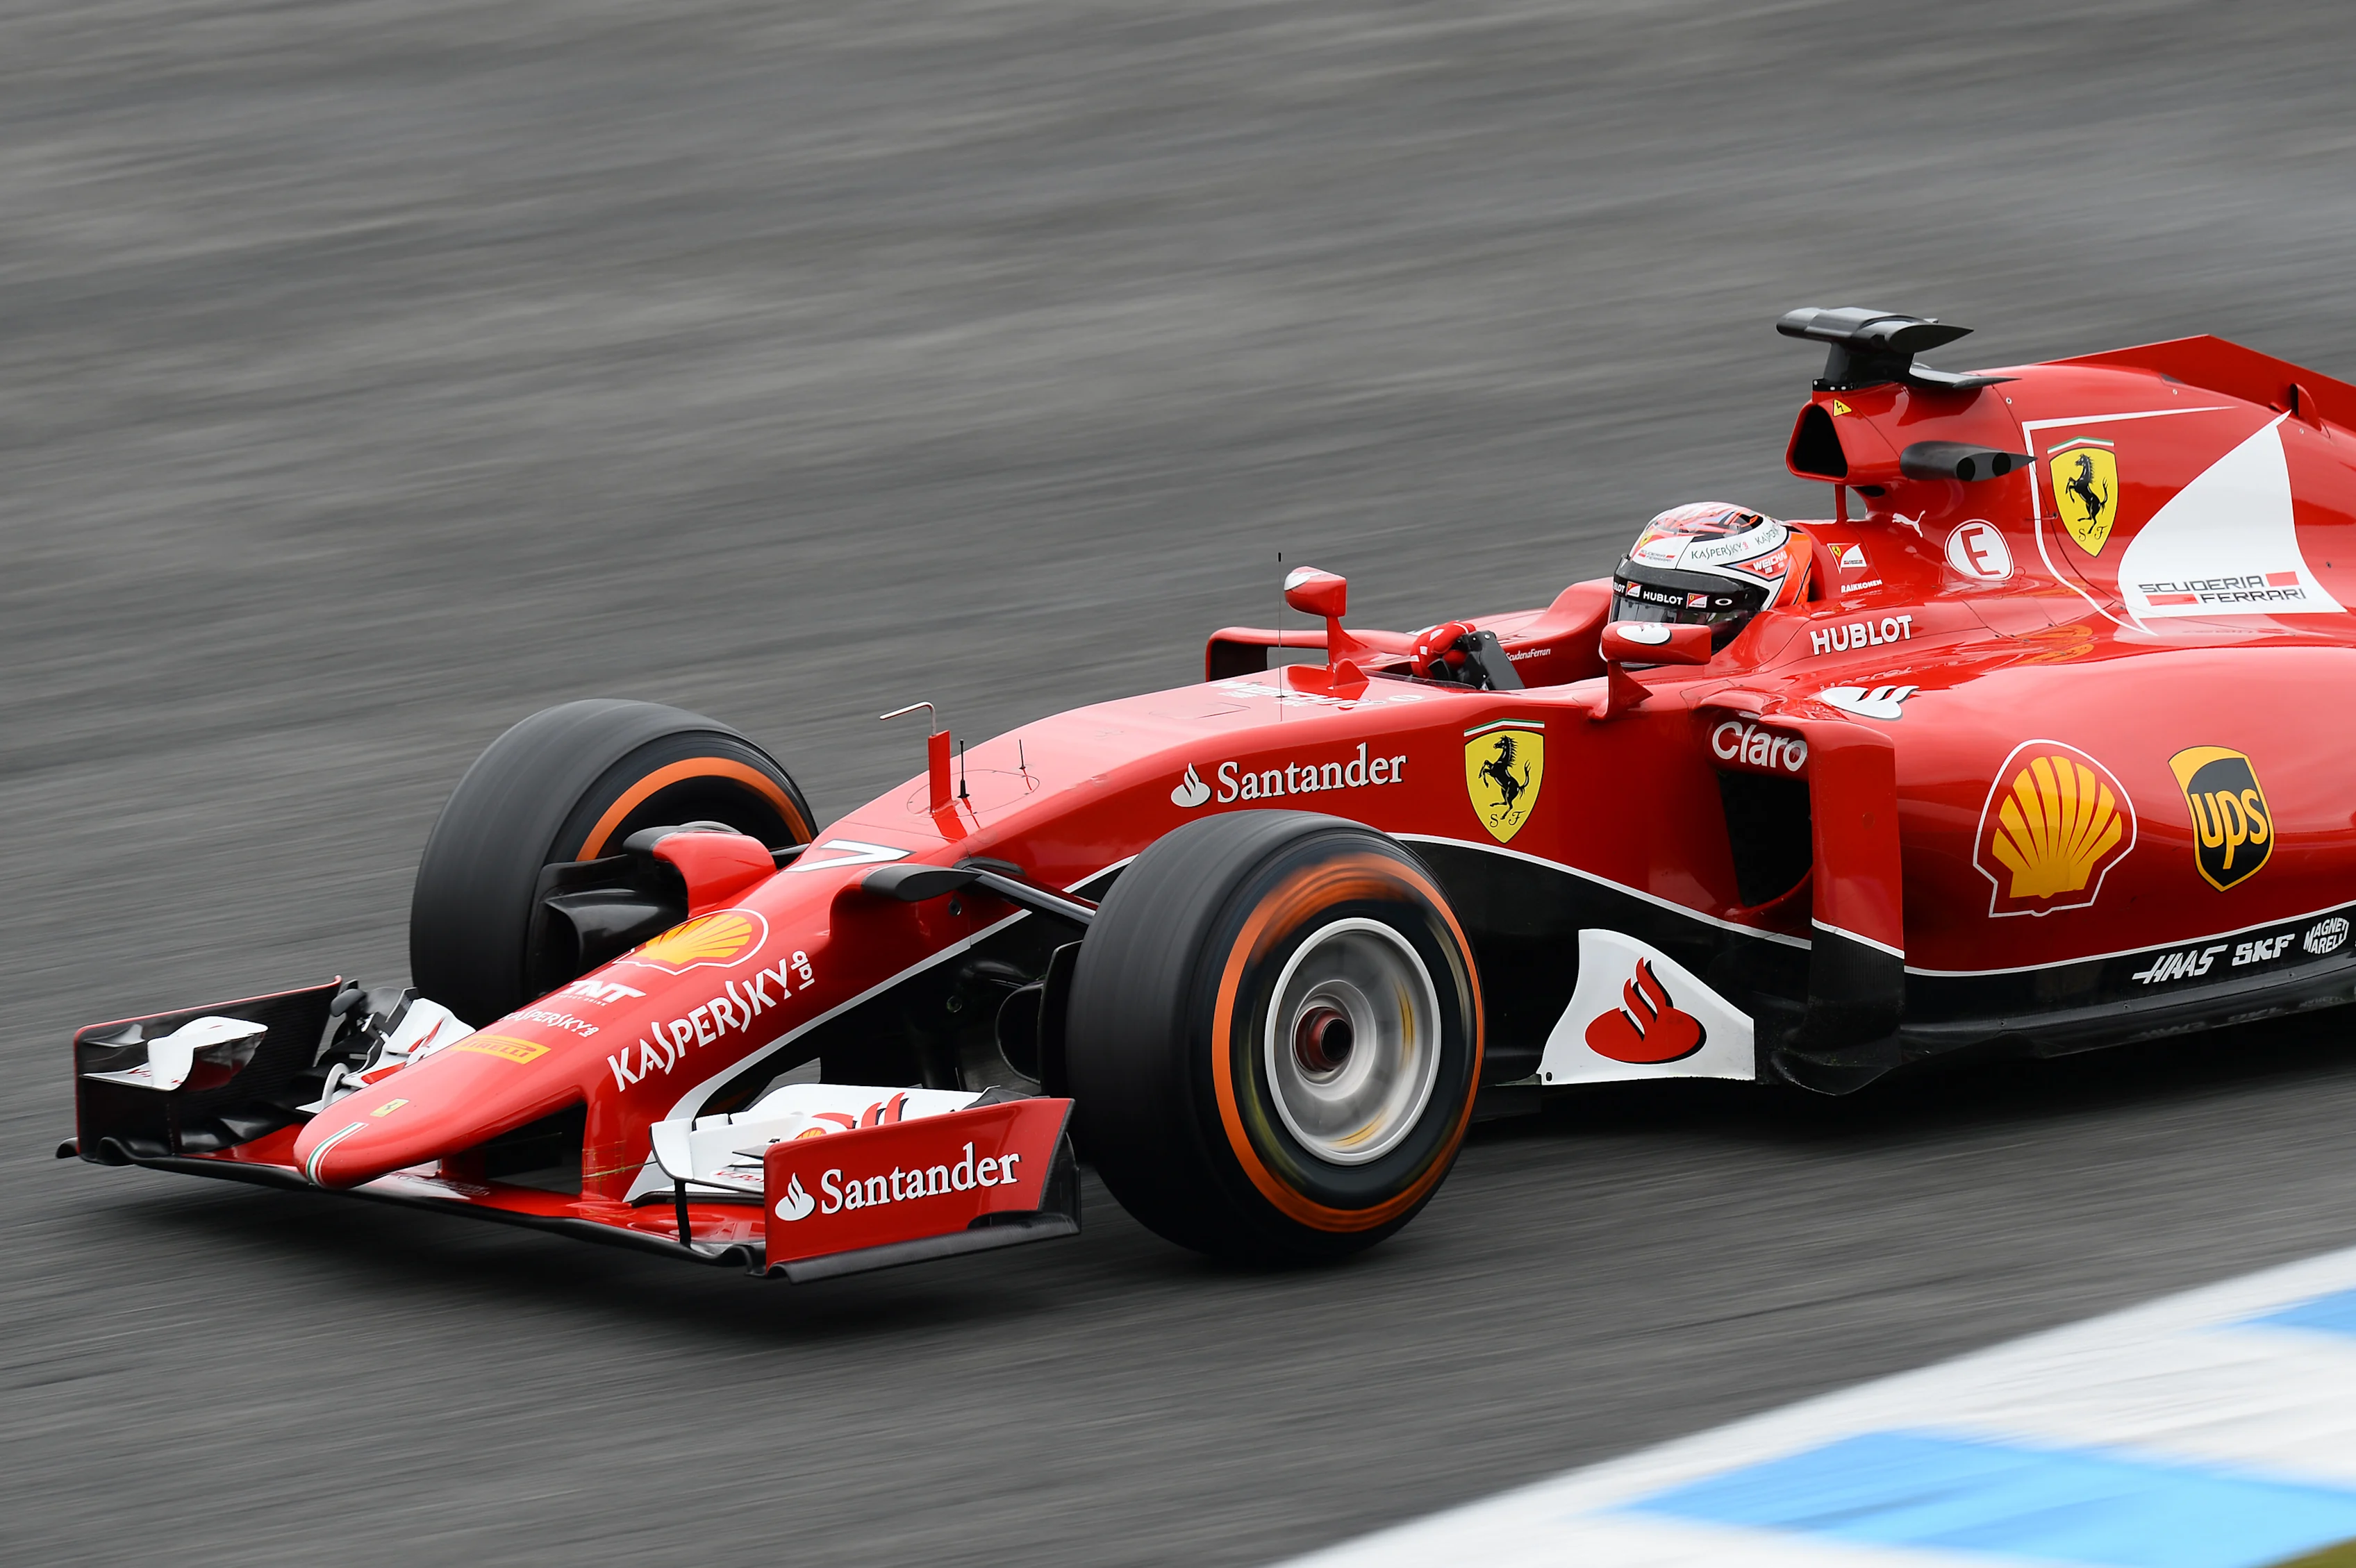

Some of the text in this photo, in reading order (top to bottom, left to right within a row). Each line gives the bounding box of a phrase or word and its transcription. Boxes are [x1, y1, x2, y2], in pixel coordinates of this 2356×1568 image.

[1691, 542, 1743, 560] KASPERSKY
[1753, 551, 1788, 572] WEICHAI
[1960, 526, 2002, 576] E
[1643, 590, 1684, 606] HUBLOT
[1841, 578, 1883, 594] RAIKKONEN
[2138, 575, 2265, 593] SCUDERIA
[2199, 588, 2307, 603] FERRARI
[1809, 615, 1913, 656] HUBLOT
[1711, 721, 1808, 772] Claro
[1217, 742, 1407, 803] Santander
[782, 838, 915, 873] 7
[2131, 944, 2228, 985] HAAS
[2232, 934, 2295, 966] SKF
[561, 981, 647, 1003] TNT
[606, 958, 792, 1093] KASPERSKY
[461, 1037, 537, 1058] PIRELLI
[821, 1142, 1020, 1215] Santander
